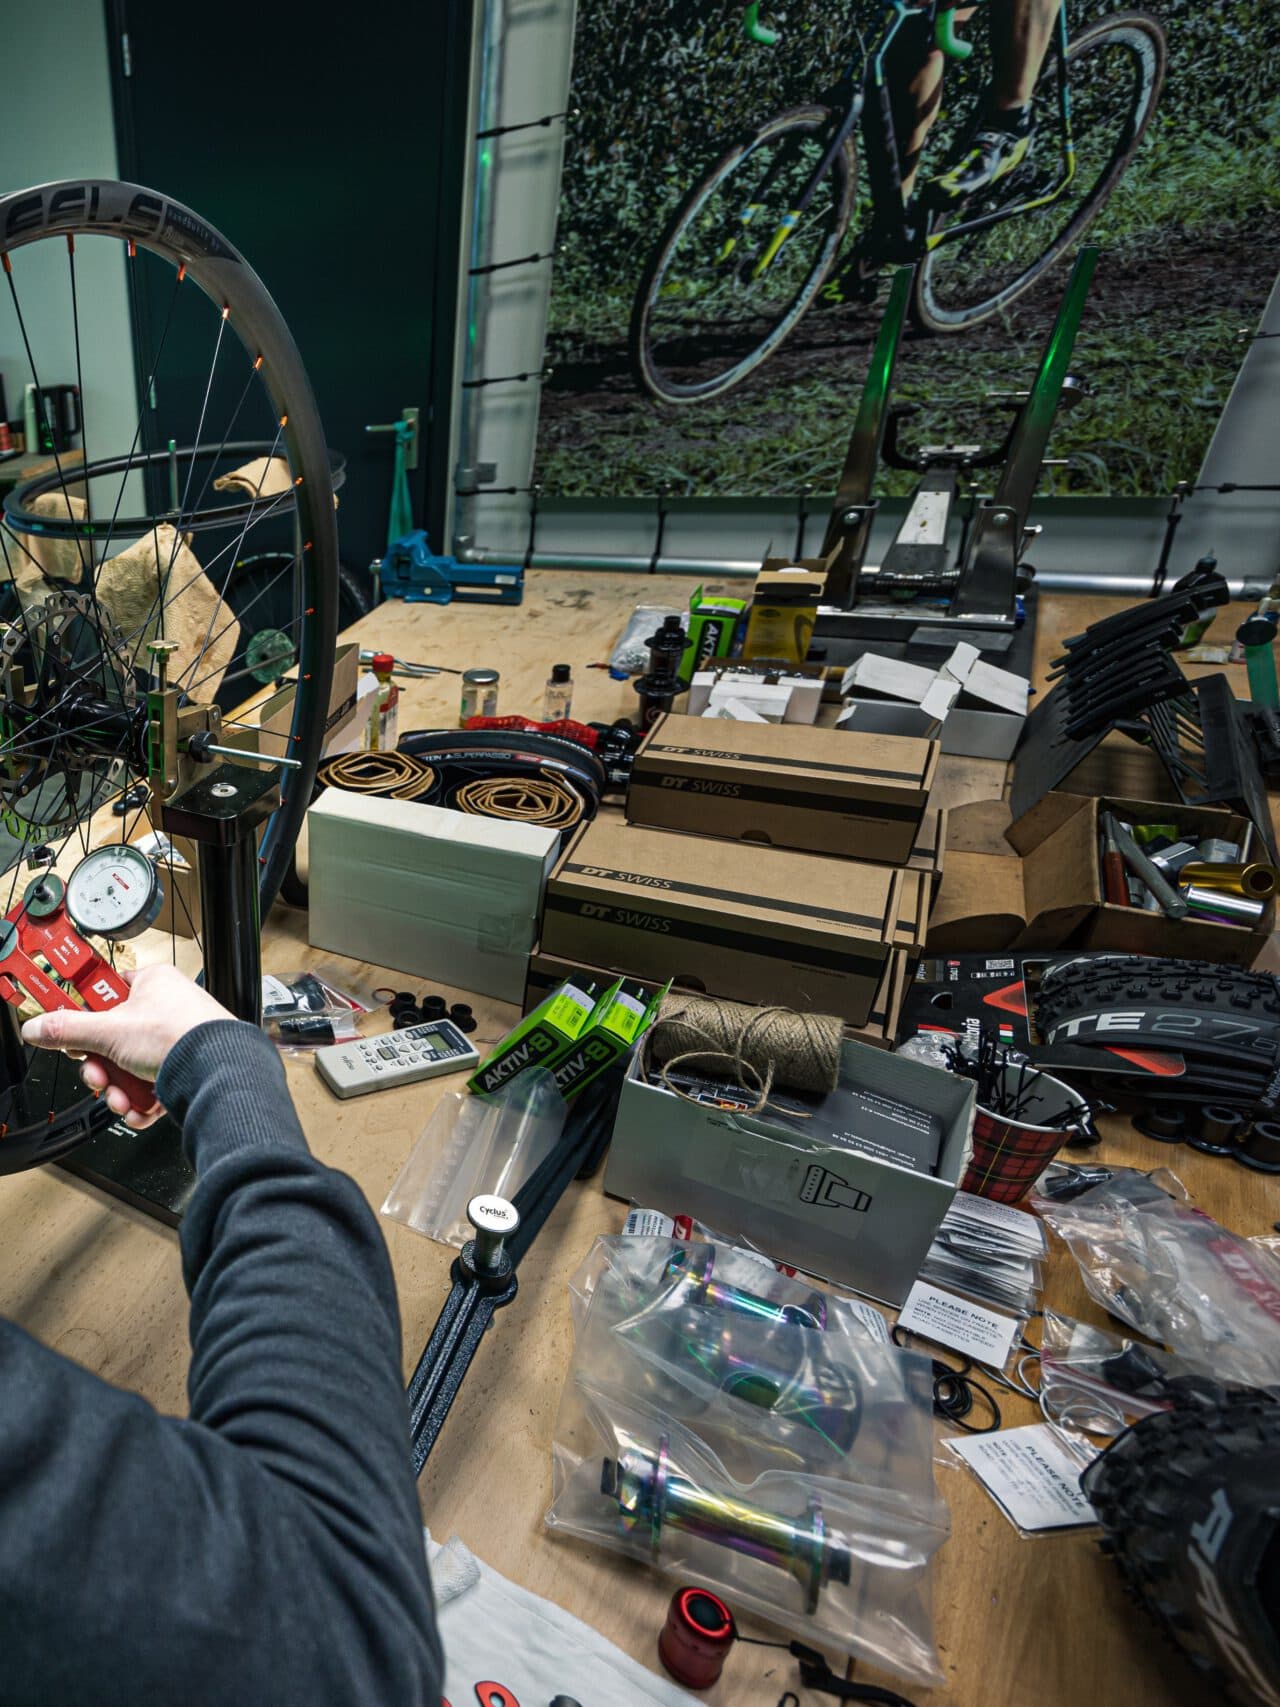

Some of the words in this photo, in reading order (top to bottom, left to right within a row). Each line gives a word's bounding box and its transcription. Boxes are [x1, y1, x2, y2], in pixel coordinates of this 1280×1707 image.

[693, 749, 742, 760] SWISS
[661, 776, 689, 787] DT
[691, 780, 741, 797] SWISS
[580, 866, 613, 877] DT
[615, 872, 673, 889] SWISS
[580, 903, 611, 918] DT
[614, 910, 673, 933] SWISS
[92, 979, 120, 1002] DT
[479, 1205, 507, 1217] Cyclus
[928, 1295, 969, 1316] PLEASE
[969, 1312, 1000, 1330] NOTE
[1026, 1446, 1061, 1480] PLEASE
[1058, 1481, 1086, 1508] NOTE
